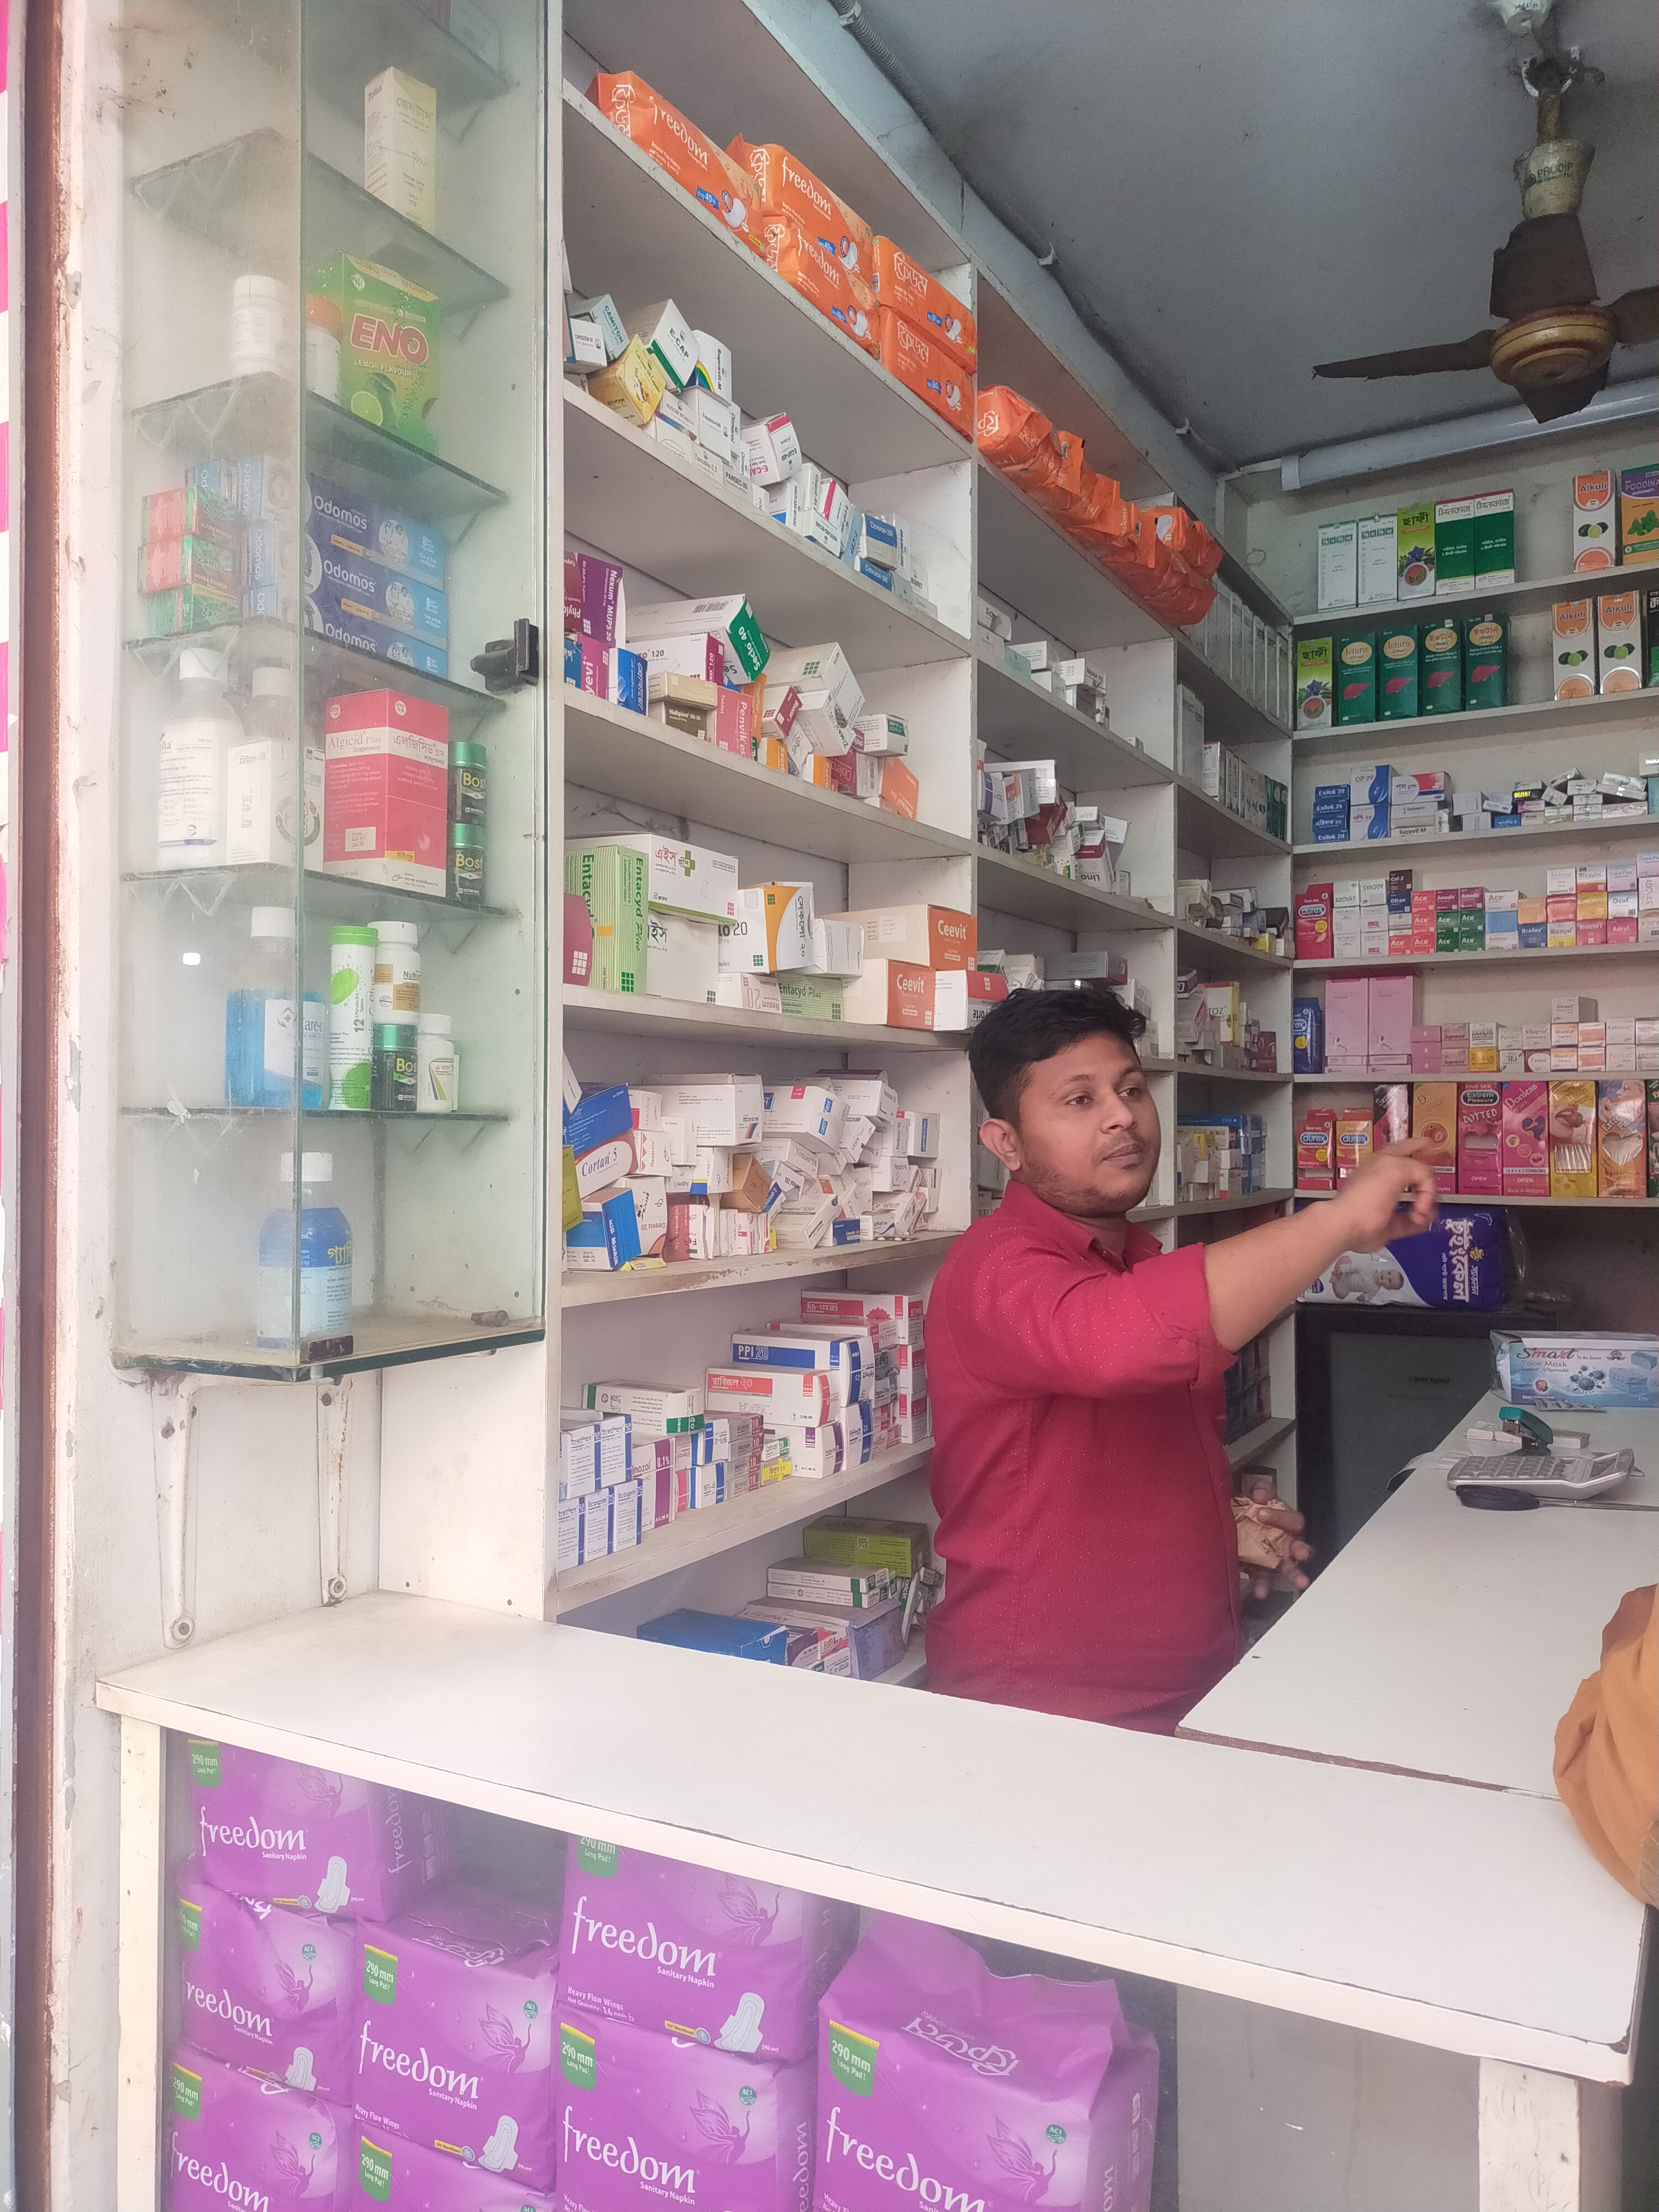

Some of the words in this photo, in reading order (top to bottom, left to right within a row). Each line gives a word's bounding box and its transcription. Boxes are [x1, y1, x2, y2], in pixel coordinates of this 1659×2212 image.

[649, 96, 708, 165] freedom
[781, 156, 832, 216] freedom
[797, 228, 839, 285] freedom
[893, 252, 928, 297] ফ্রিডম
[350, 313, 429, 366] ENO
[669, 327, 690, 359] E-CAP
[897, 320, 930, 364] ফ্রিডম
[354, 359, 379, 371] LEMON
[380, 365, 412, 378] FLAVOUR
[1579, 481, 1607, 493] Alkuli
[1438, 504, 1472, 518] সিনকারা
[1476, 497, 1510, 511] সিনকারা
[314, 495, 369, 531] Odomos
[1402, 511, 1430, 527] ছাফী
[324, 560, 377, 594] Odomos
[608, 569, 618, 601] Nexum
[1559, 610, 1585, 622] Alkuli
[1605, 602, 1632, 614] Alkuli
[606, 604, 614, 631] MUPS
[325, 623, 377, 654] Odomos
[606, 630, 612, 643] 20
[738, 626, 747, 641] 40
[651, 649, 665, 658] 120
[747, 641, 761, 671] Seclo
[1302, 646, 1328, 660] ছাফী
[739, 701, 748, 743] Penvik
[328, 735, 363, 750] Algicid
[352, 745, 382, 753] Suspension
[740, 743, 747, 757] DS
[655, 846, 677, 867] এইস
[635, 857, 644, 919] Entacyd
[1335, 895, 1357, 904] ADOVAS
[1413, 895, 1428, 903] Ace
[635, 922, 643, 952] Plus
[733, 922, 748, 936] 20
[937, 920, 967, 941] Ceevit
[779, 983, 806, 998] Entacyd
[808, 987, 823, 998] Plus
[896, 973, 925, 994] Ceevit
[747, 987, 761, 1010] 20
[761, 1000, 780, 1011] Nexum
[353, 1019, 365, 1033] 12
[397, 1058, 419, 1073] Bos
[1462, 1108, 1498, 1125] DOTTED
[1302, 1134, 1327, 1143] durex
[1342, 1134, 1367, 1143] durex
[581, 1154, 610, 1177] Cortan
[612, 1147, 618, 1162] 5
[738, 1345, 754, 1358] PPI
[756, 1345, 769, 1361] 20
[1516, 1347, 1577, 1360] Smart
[712, 1377, 739, 1388] রাবিজল
[740, 1379, 753, 1391] ২০
[737, 1423, 750, 1432] Monas
[752, 1417, 759, 1428] 10
[753, 1437, 759, 1447] 10
[656, 1455, 671, 1469] 0.1%
[749, 1456, 757, 1467] 10
[749, 1474, 757, 1484] 10
[588, 1497, 608, 1509] Ecosprin
[608, 1493, 614, 1503] 75
[618, 1488, 637, 1500] Ecosprin
[637, 1486, 643, 1495] 75
[655, 1514, 670, 1522] ACME
[192, 1753, 205, 1766] 290
[205, 1755, 218, 1767] mm
[199, 1806, 307, 1857] freedom
[261, 1851, 285, 1861] Sanitary
[285, 1852, 307, 1861] Napkin
[584, 1848, 597, 1859] Long
[597, 1852, 611, 1864] Pad!
[572, 1896, 716, 1977] freedom
[366, 1960, 380, 1978] 290
[380, 1966, 394, 1983] mm
[657, 1965, 687, 1983] Sanitary
[687, 1973, 715, 1989] Napkin
[368, 1976, 380, 1987] Long
[525, 2002, 536, 2011] ACI
[567, 1985, 587, 2001] Heavy
[587, 1991, 603, 2005] Flow
[602, 1996, 624, 2012] Wings
[185, 1980, 273, 2038] reedom
[602, 2005, 613, 2016] 16
[233, 2024, 255, 2038] Sanitary
[358, 2020, 480, 2101] freedom
[561, 2040, 577, 2058] 290
[576, 2051, 594, 2068] mm
[831, 2039, 850, 2063] 290
[851, 2052, 872, 2074] mm
[566, 2057, 580, 2071] Long
[578, 2062, 591, 2076] Pad!
[836, 2058, 853, 2075] Long
[852, 2064, 867, 2083] Pad!
[172, 2077, 186, 2094] 290
[185, 2086, 199, 2101] mm
[741, 2088, 754, 2097] ACI
[428, 2087, 454, 2104] Sanitary
[453, 2094, 478, 2111] Napkin
[354, 2102, 369, 2119] Heavy
[369, 2110, 383, 2124] Flow
[382, 2115, 400, 2131] Wings
[311, 2133, 321, 2142] ACI
[1047, 2125, 1063, 2135] ACI
[562, 2105, 696, 2195] freedom
[361, 2153, 375, 2172] 290
[375, 2163, 390, 2180] mm
[826, 2105, 987, 2212] freedom
[639, 2180, 670, 2199] Sanitary
[669, 2189, 696, 2206] Napkin
